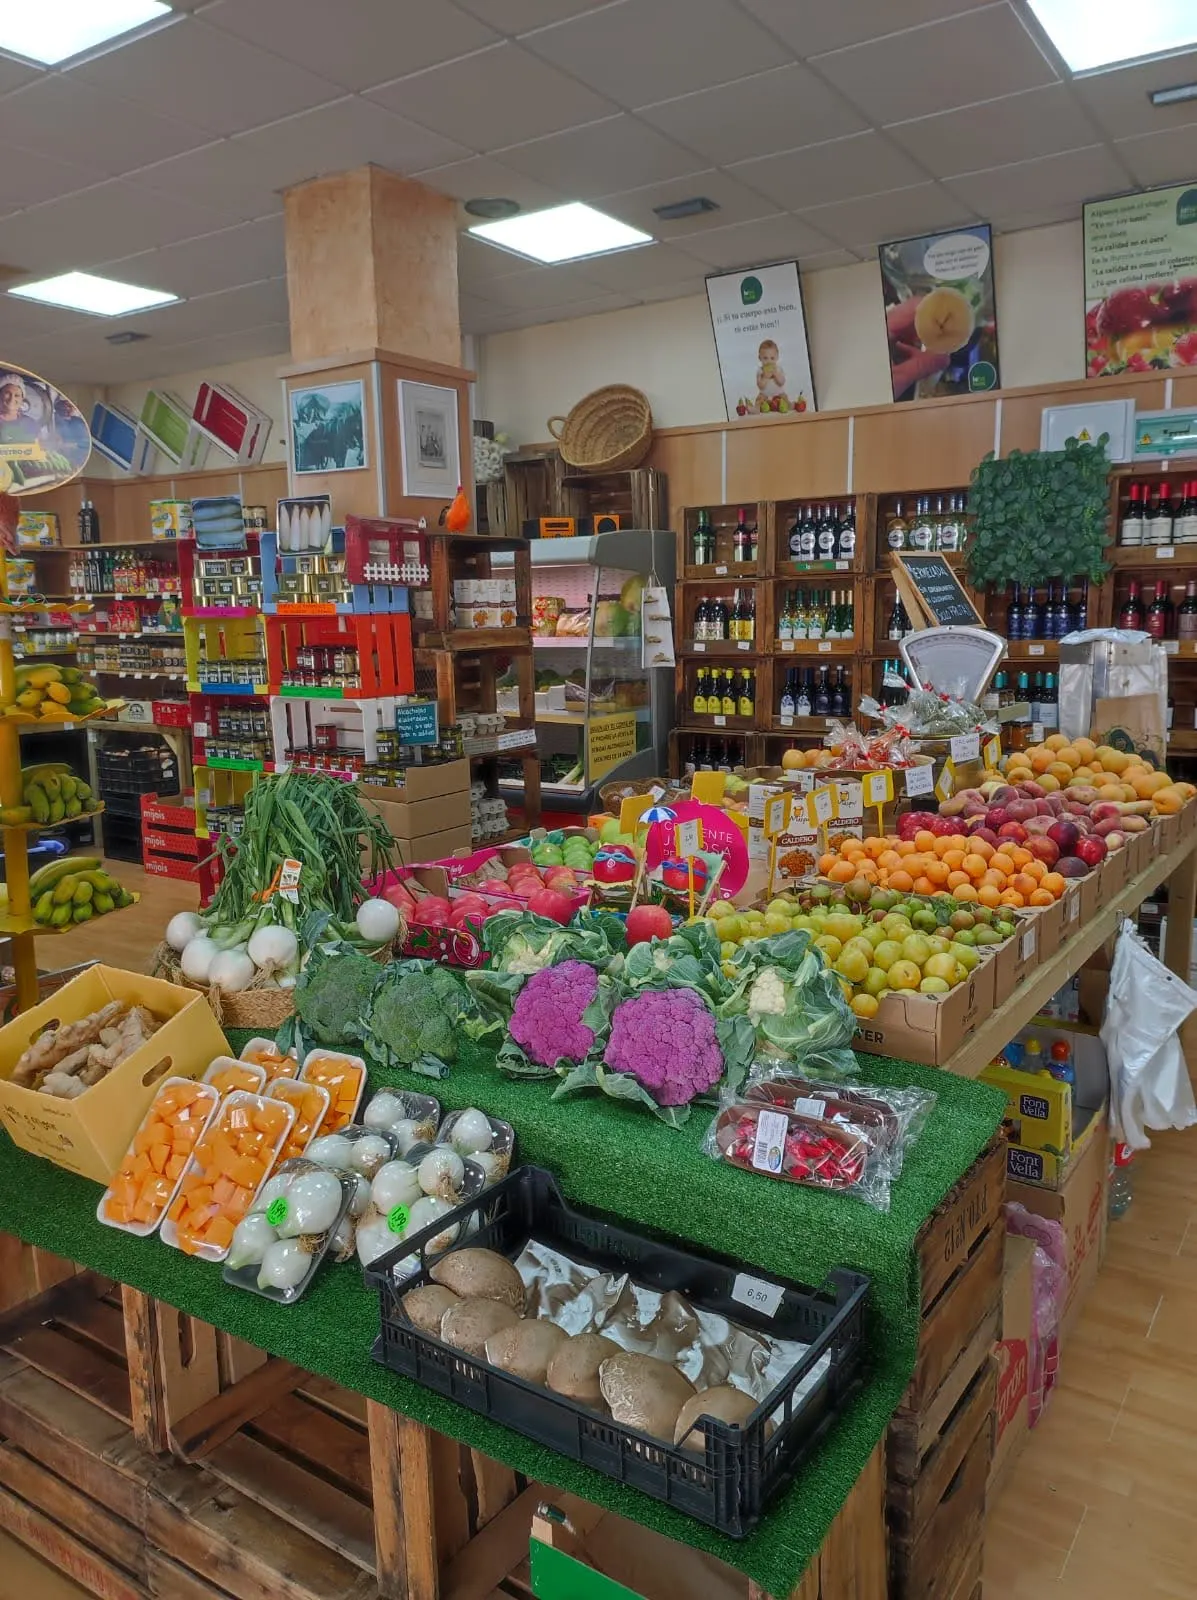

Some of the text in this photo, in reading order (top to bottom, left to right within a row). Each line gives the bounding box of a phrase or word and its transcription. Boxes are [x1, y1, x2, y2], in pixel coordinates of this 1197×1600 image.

[740, 310, 761, 318] cuerpo
[828, 818, 859, 826] CALDERO
[781, 835, 814, 845] CALDERO
[1022, 1096, 1046, 1110] Font
[1022, 1104, 1046, 1118] Vella
[1010, 1150, 1039, 1167] Font
[1010, 1161, 1039, 1178] Vella
[747, 1288, 768, 1302] 6,50
